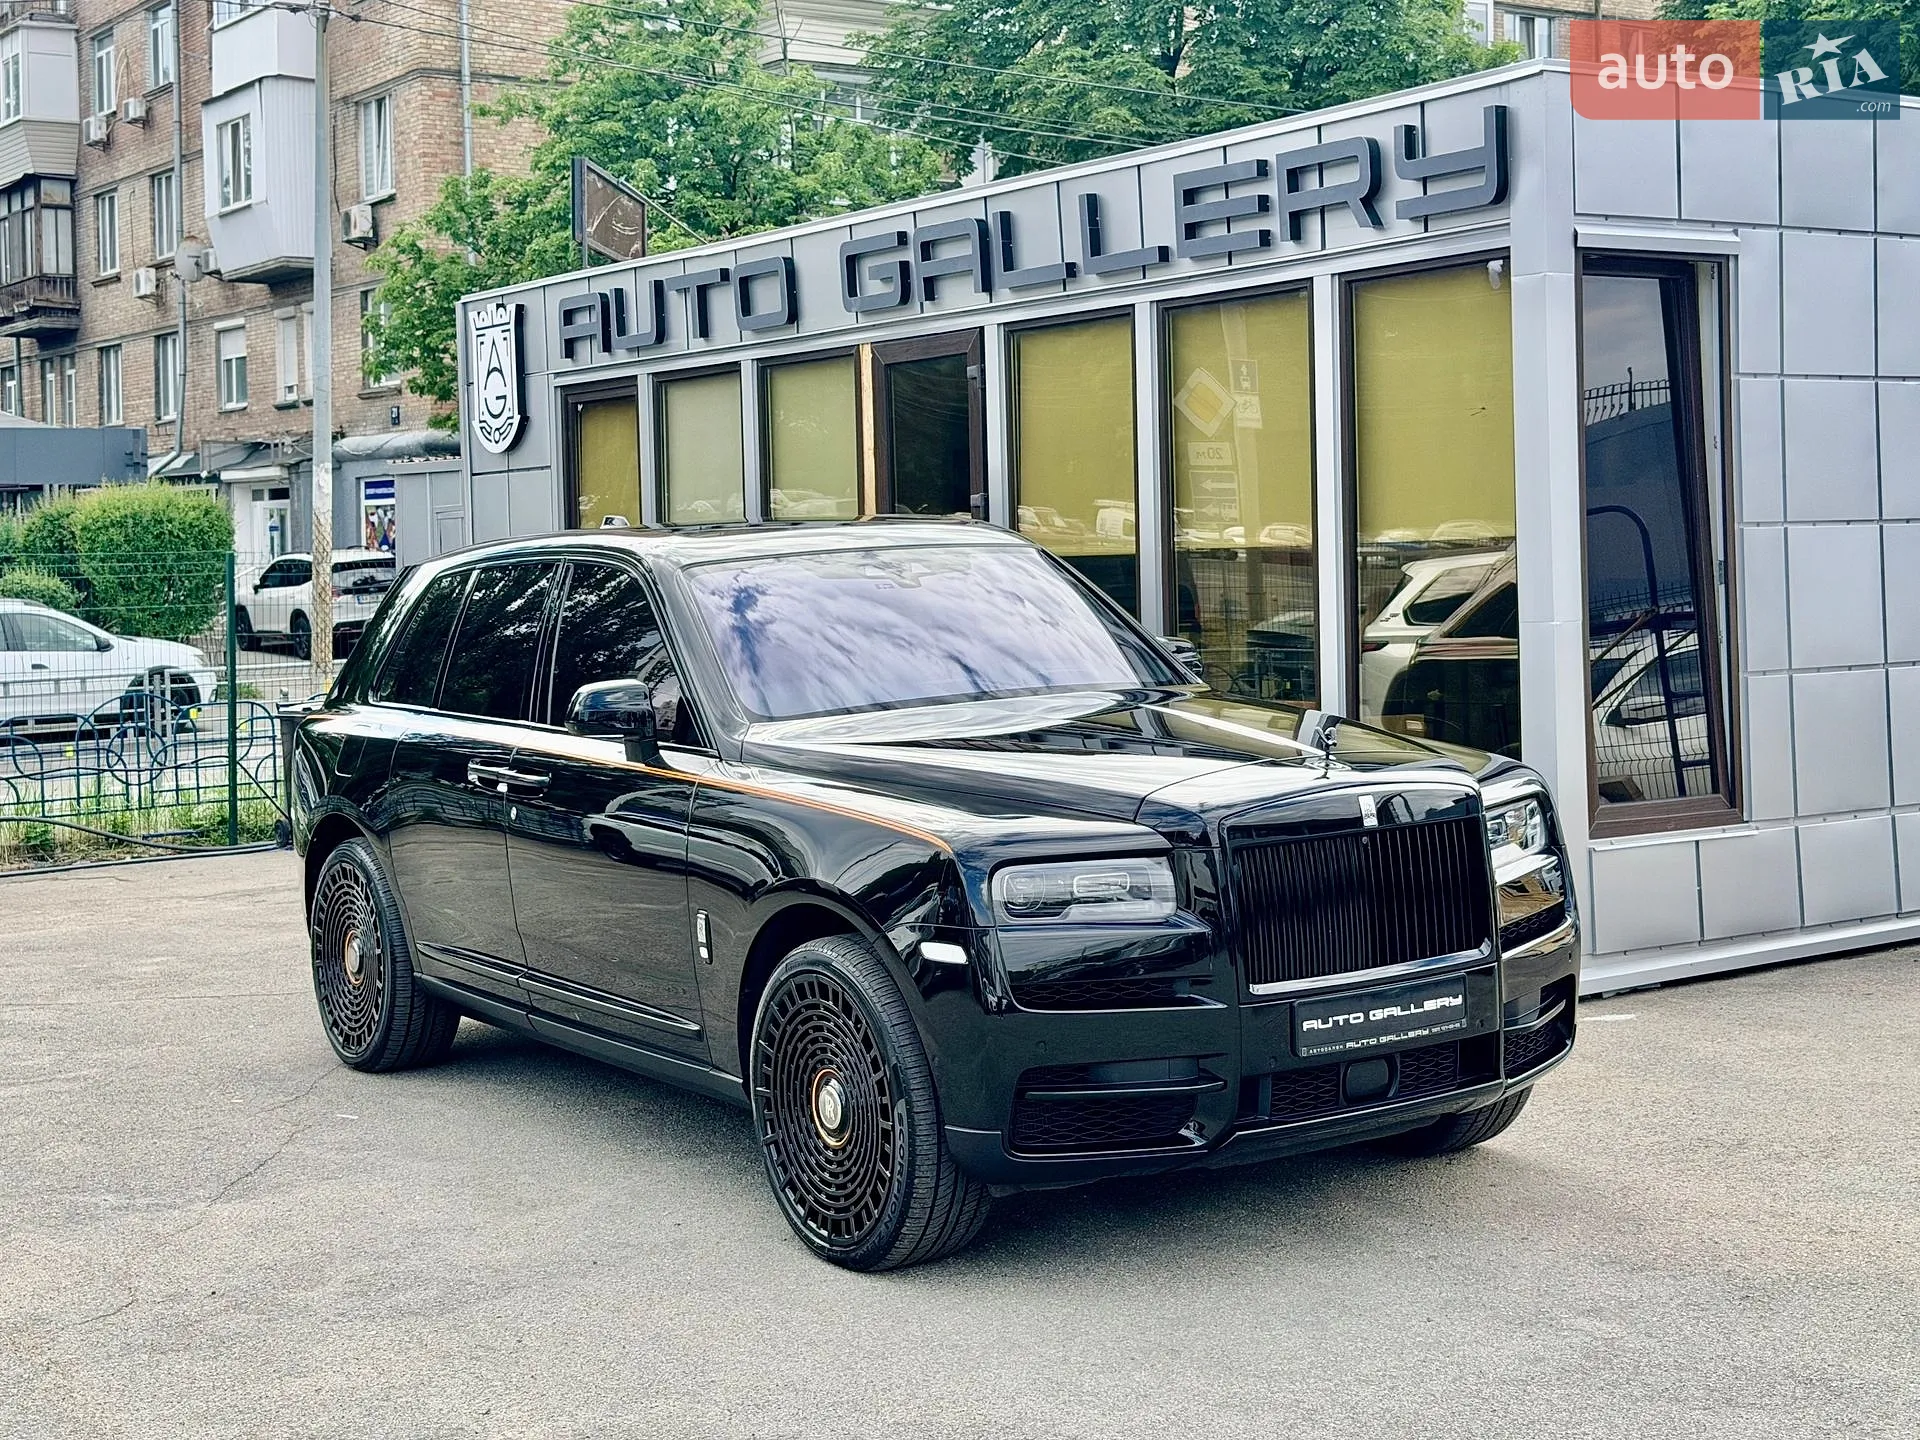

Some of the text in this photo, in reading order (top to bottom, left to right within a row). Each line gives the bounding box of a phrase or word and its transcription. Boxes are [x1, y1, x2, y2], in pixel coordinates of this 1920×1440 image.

[557, 104, 1509, 360] AUTO GALLERY
[1302, 994, 1463, 1032] AUTO GALLERY
[1345, 1037, 1378, 1049] AUTO
[1379, 1028, 1429, 1043] GALLERY
[884, 1111, 906, 1230] SCORPION
